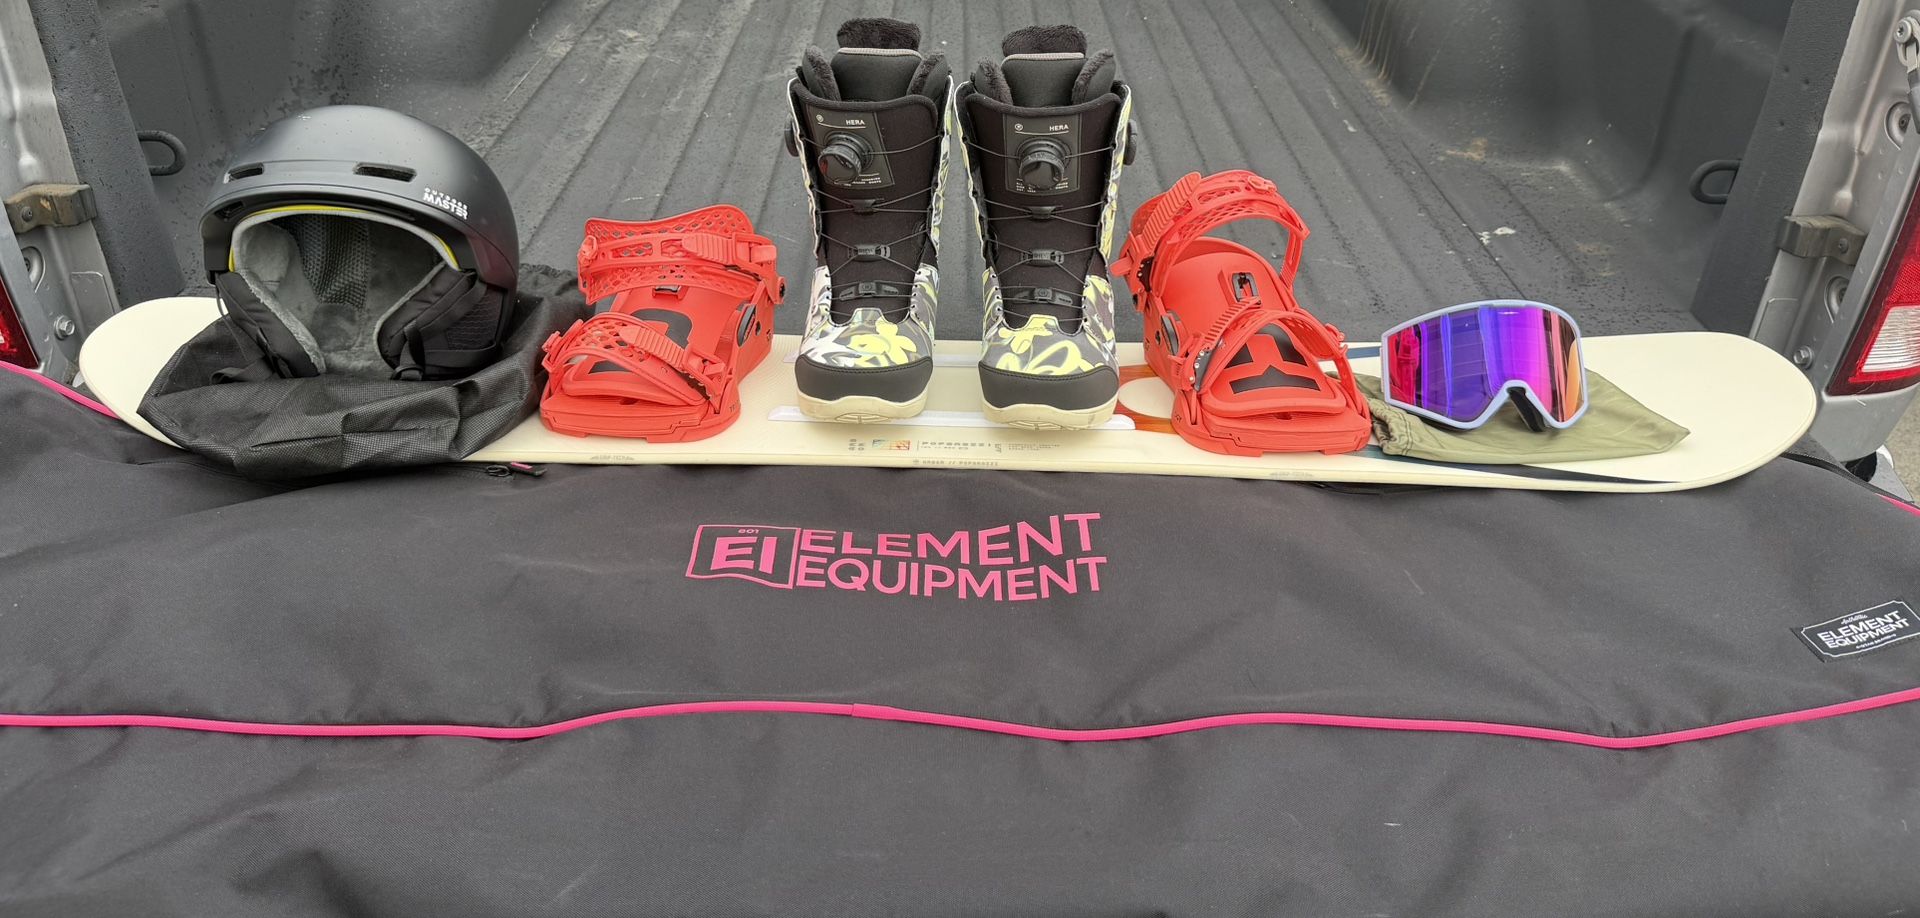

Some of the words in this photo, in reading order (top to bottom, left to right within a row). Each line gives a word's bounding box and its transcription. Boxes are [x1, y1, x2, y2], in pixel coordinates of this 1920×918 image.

[1049, 123, 1070, 132] HERA
[423, 192, 469, 220] MASTER
[710, 536, 779, 575] EI
[799, 513, 1101, 567] ELEMENT
[796, 556, 1108, 602] EQUIPMENT
[1817, 610, 1900, 642] ELEMENT
[1825, 618, 1910, 649] EQUIPMENT
